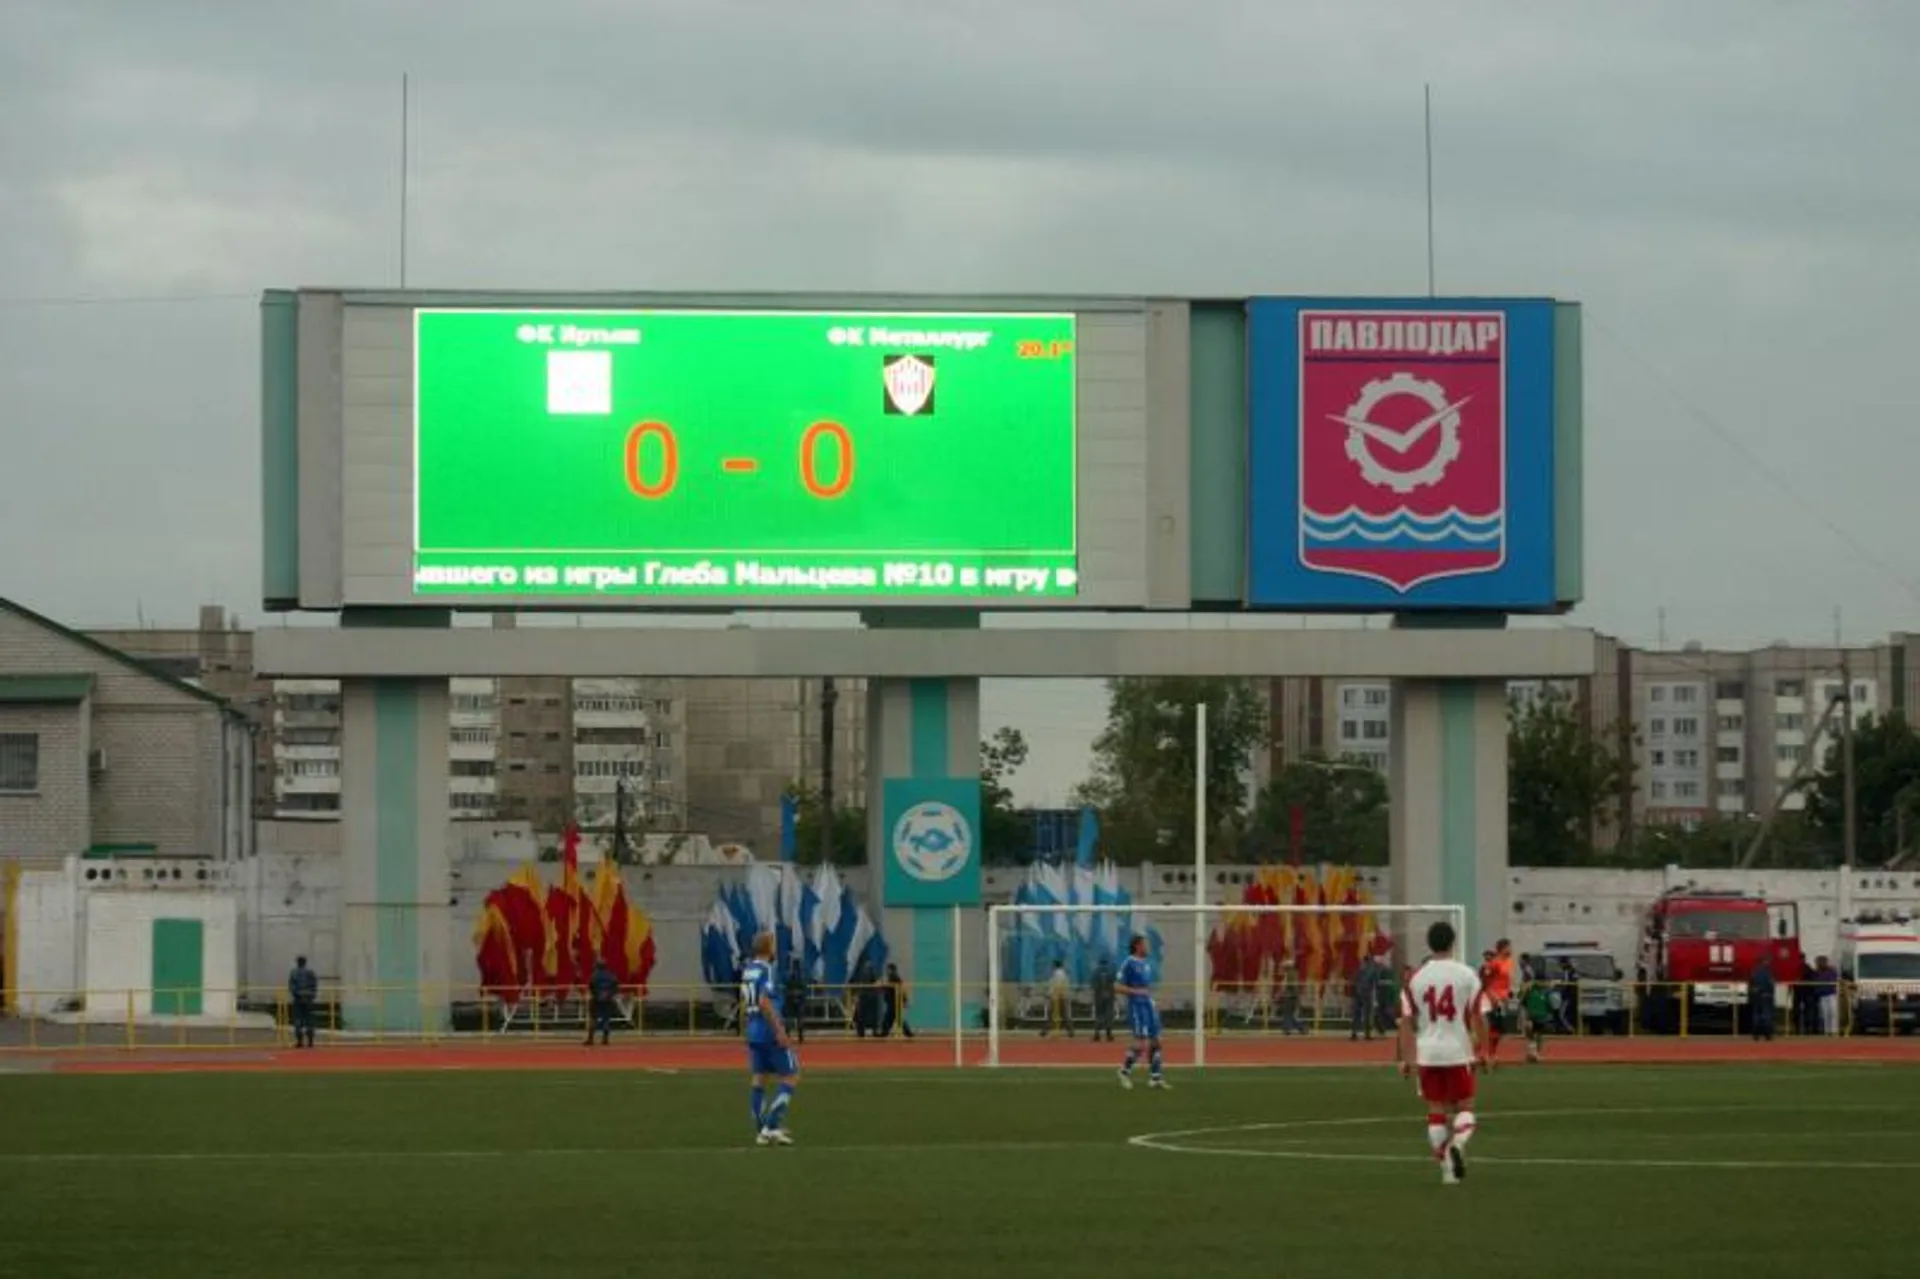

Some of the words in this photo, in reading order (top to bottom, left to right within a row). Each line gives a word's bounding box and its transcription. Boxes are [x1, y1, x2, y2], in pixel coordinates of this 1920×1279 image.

[516, 324, 554, 344] ФК
[827, 326, 865, 346] ФК
[1309, 318, 1499, 355] ПАВЛОДАР
[625, 420, 678, 498] 0
[800, 420, 854, 498] 0
[564, 566, 637, 590] игры
[643, 561, 729, 586] Глеба
[735, 561, 877, 589] Мальцева
[882, 561, 954, 586] №10
[983, 566, 1050, 590] игру
[1421, 983, 1456, 1022] 14
